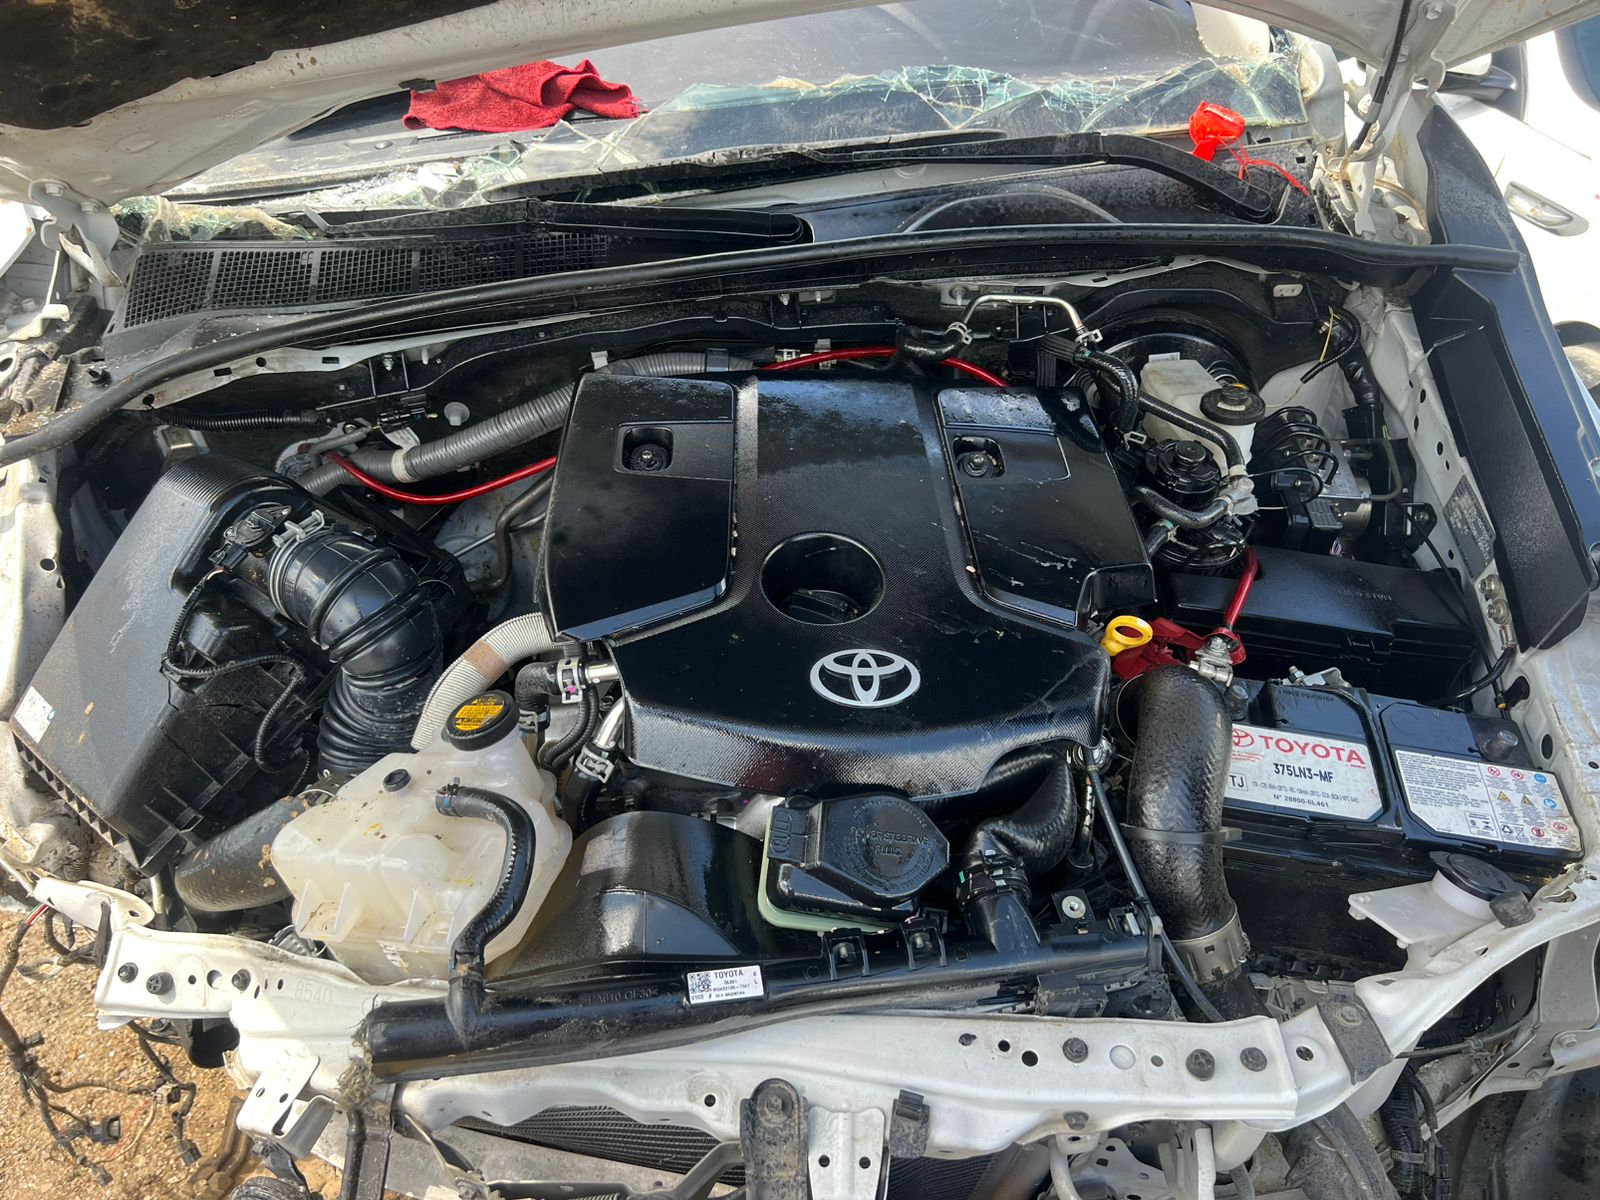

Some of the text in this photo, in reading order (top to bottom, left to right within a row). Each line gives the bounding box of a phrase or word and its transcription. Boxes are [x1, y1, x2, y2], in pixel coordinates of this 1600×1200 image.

[1259, 735, 1366, 765] TOYOTA
[1229, 775, 1244, 788] TJ
[1273, 763, 1333, 783] 375LN3-MF
[883, 832, 929, 846] STEERING
[713, 969, 744, 979] TOYOTA
[294, 981, 333, 1006] 8540
